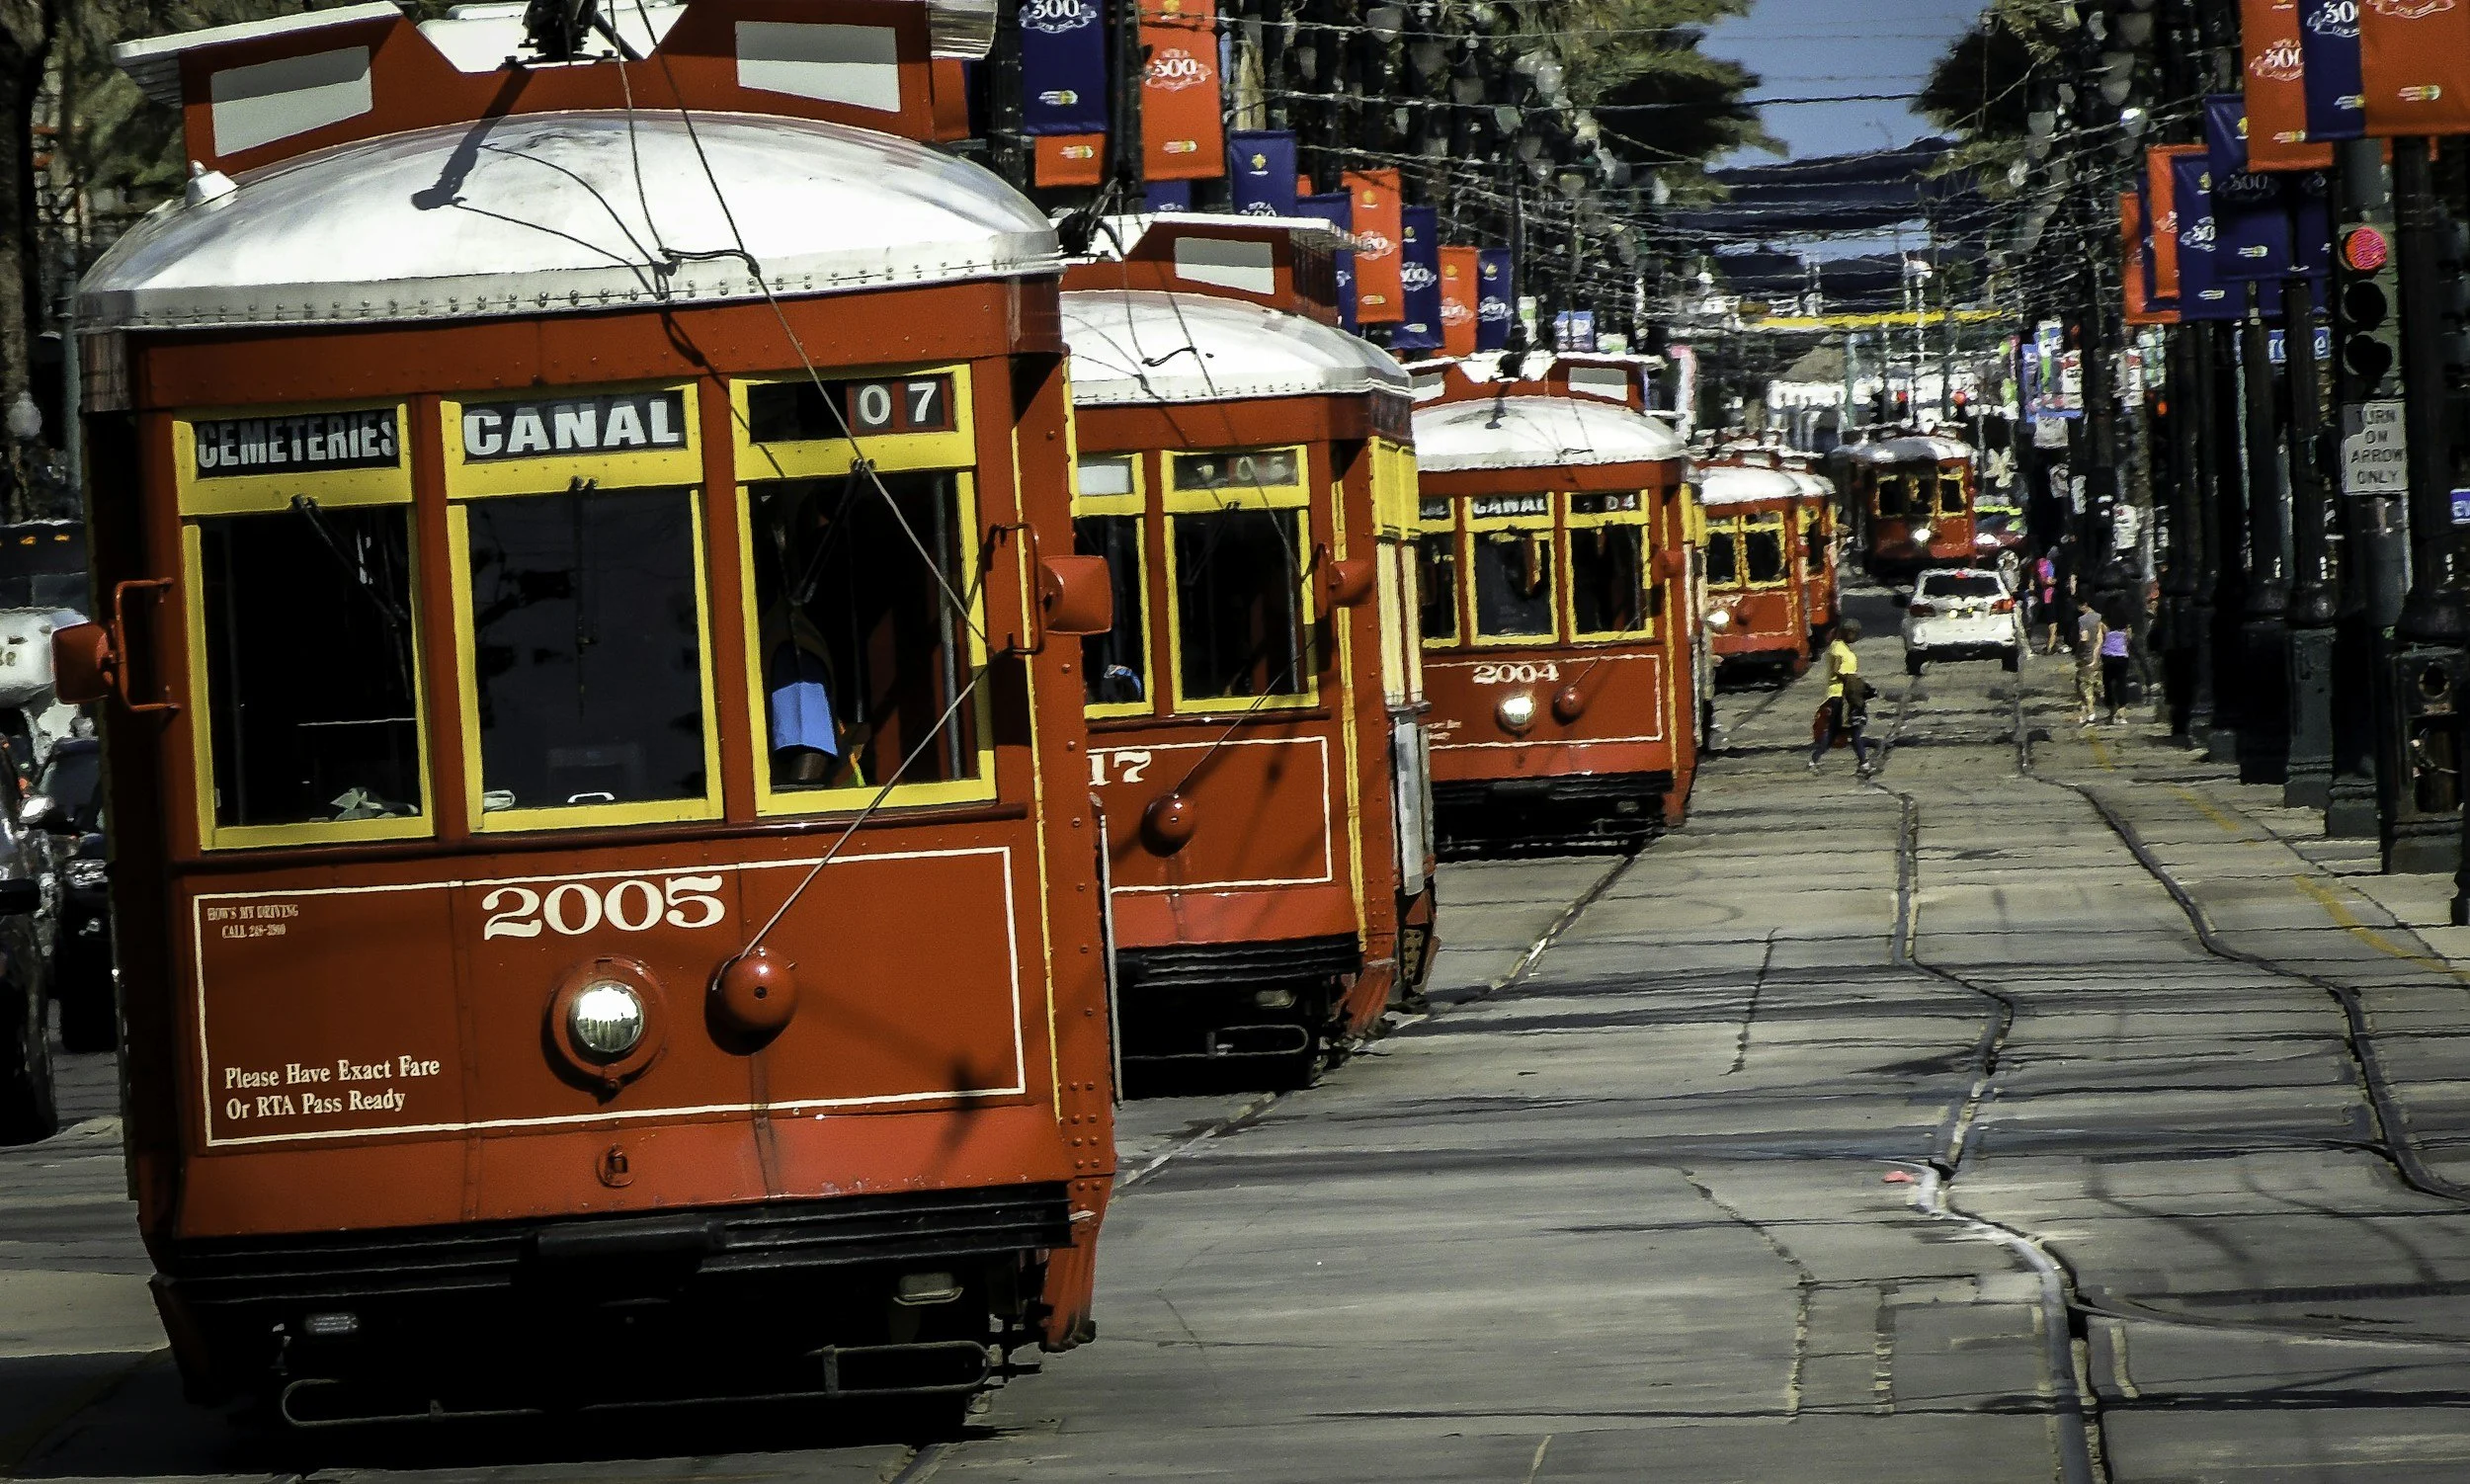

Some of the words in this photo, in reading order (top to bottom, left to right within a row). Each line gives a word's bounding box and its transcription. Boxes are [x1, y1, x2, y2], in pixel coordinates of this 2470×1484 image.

[2323, 1, 2359, 24] 30
[1155, 58, 1197, 77] 300
[463, 400, 680, 455] CANAL
[2356, 409, 2396, 425] TURN
[198, 410, 399, 468] CEMETERIES
[2364, 430, 2388, 444] ON
[2350, 448, 2405, 463] ARROW
[2357, 469, 2398, 484] ONLY
[1473, 493, 1547, 515] CANAL
[1472, 662, 1560, 685] 2004
[1086, 751, 1152, 786] 17
[256, 904, 299, 919] DRIVING
[481, 874, 726, 941] 2005
[221, 925, 247, 939] CALL
[224, 1067, 280, 1089] Please
[286, 1063, 331, 1085] Have
[337, 1059, 393, 1081] Exact
[398, 1054, 441, 1078] Fare
[226, 1098, 251, 1119] Or
[256, 1095, 296, 1118] RTA
[301, 1093, 343, 1114] Pass
[348, 1088, 406, 1113] Ready
